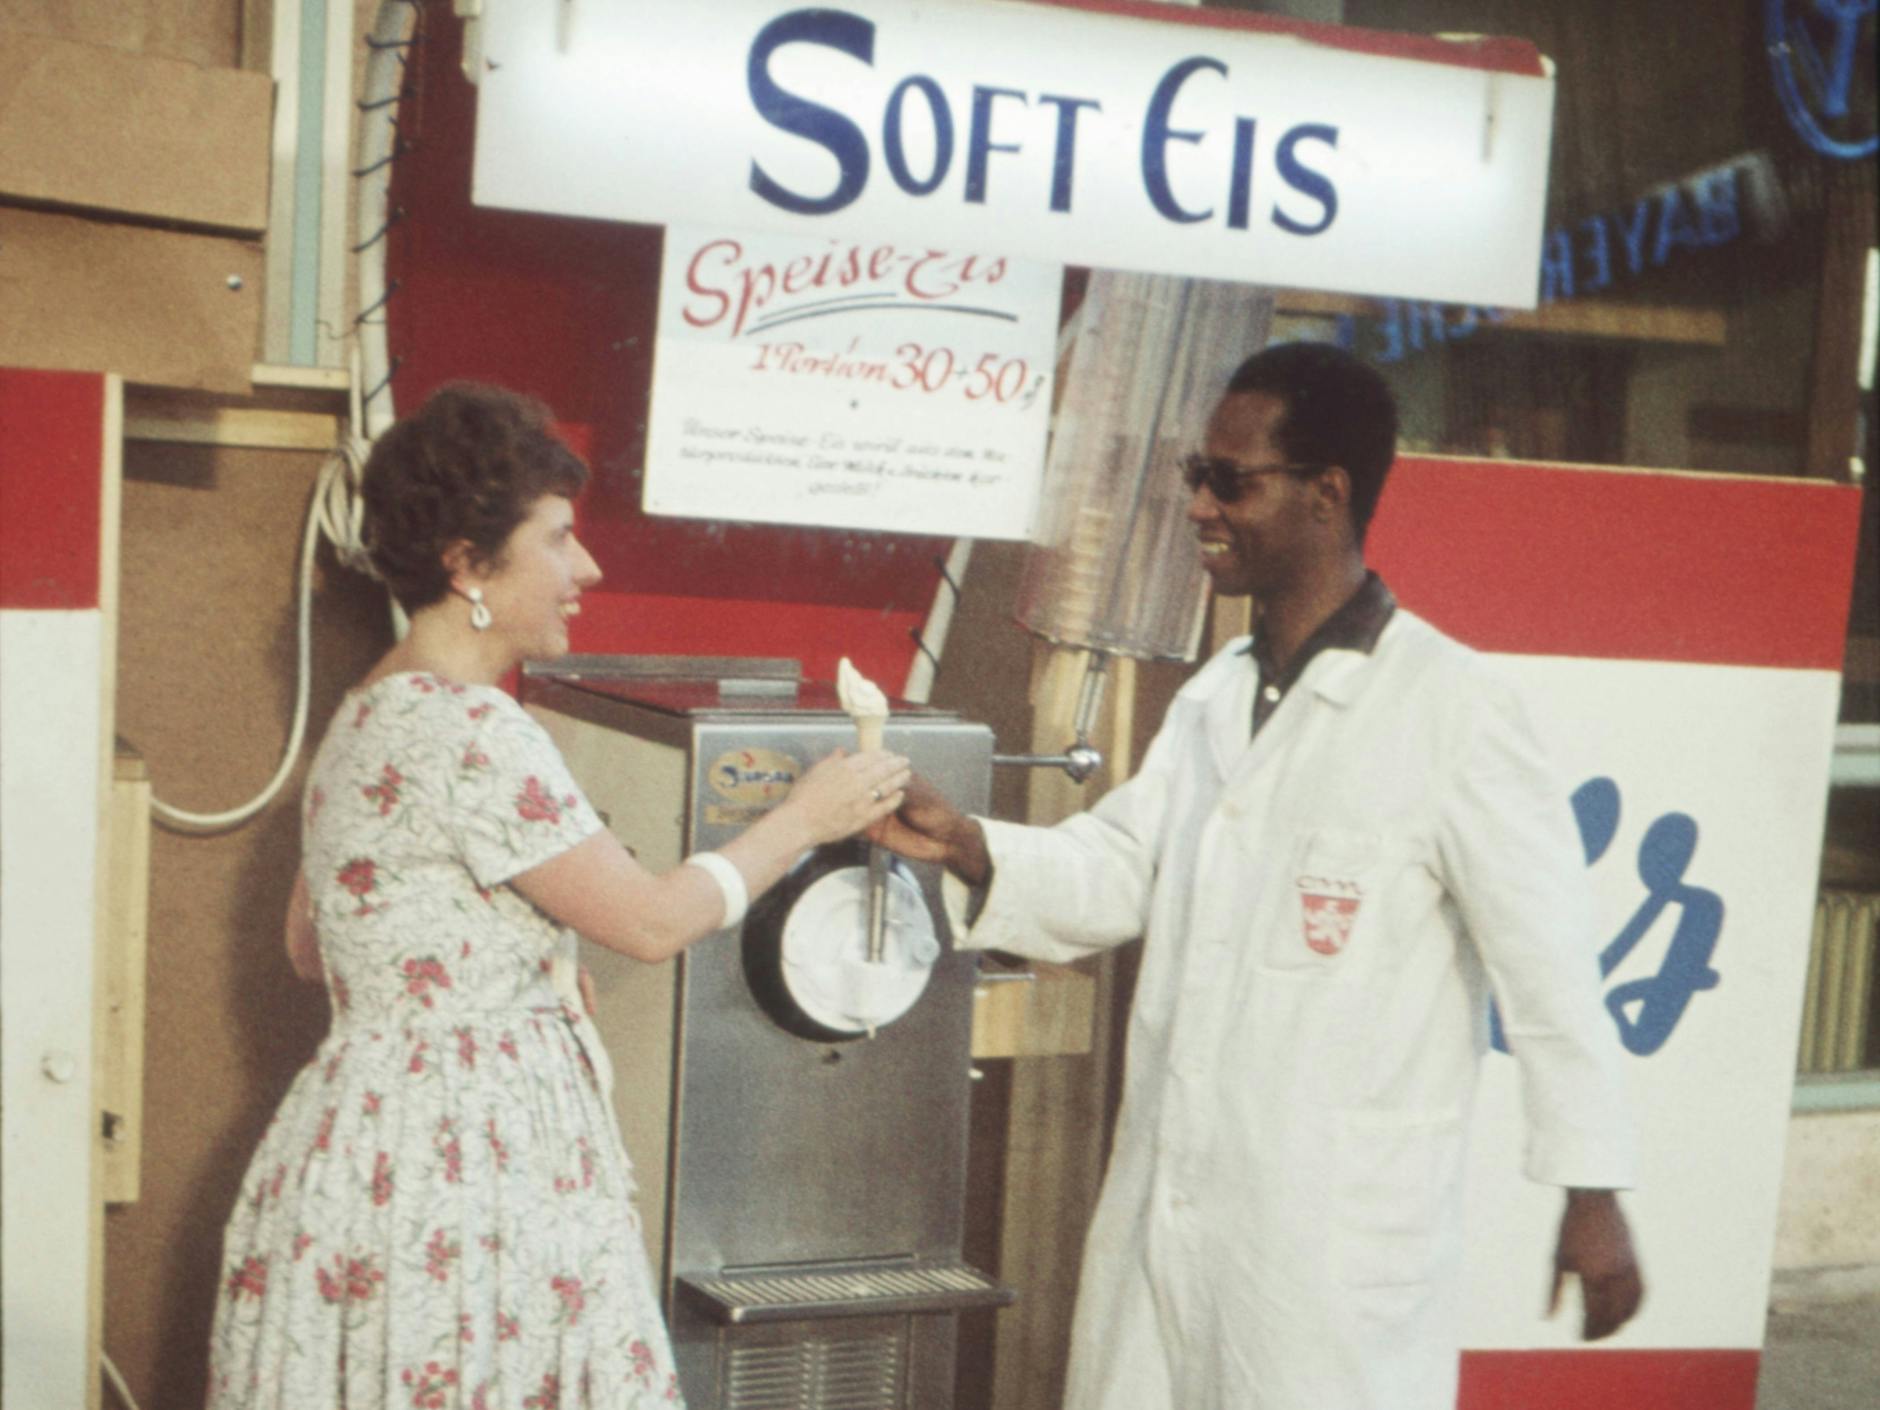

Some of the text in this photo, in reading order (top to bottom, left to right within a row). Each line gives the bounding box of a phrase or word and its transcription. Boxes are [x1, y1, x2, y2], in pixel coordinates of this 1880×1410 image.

[746, 7, 1340, 237] SOFT EIS
[775, 336, 889, 383] Portion
